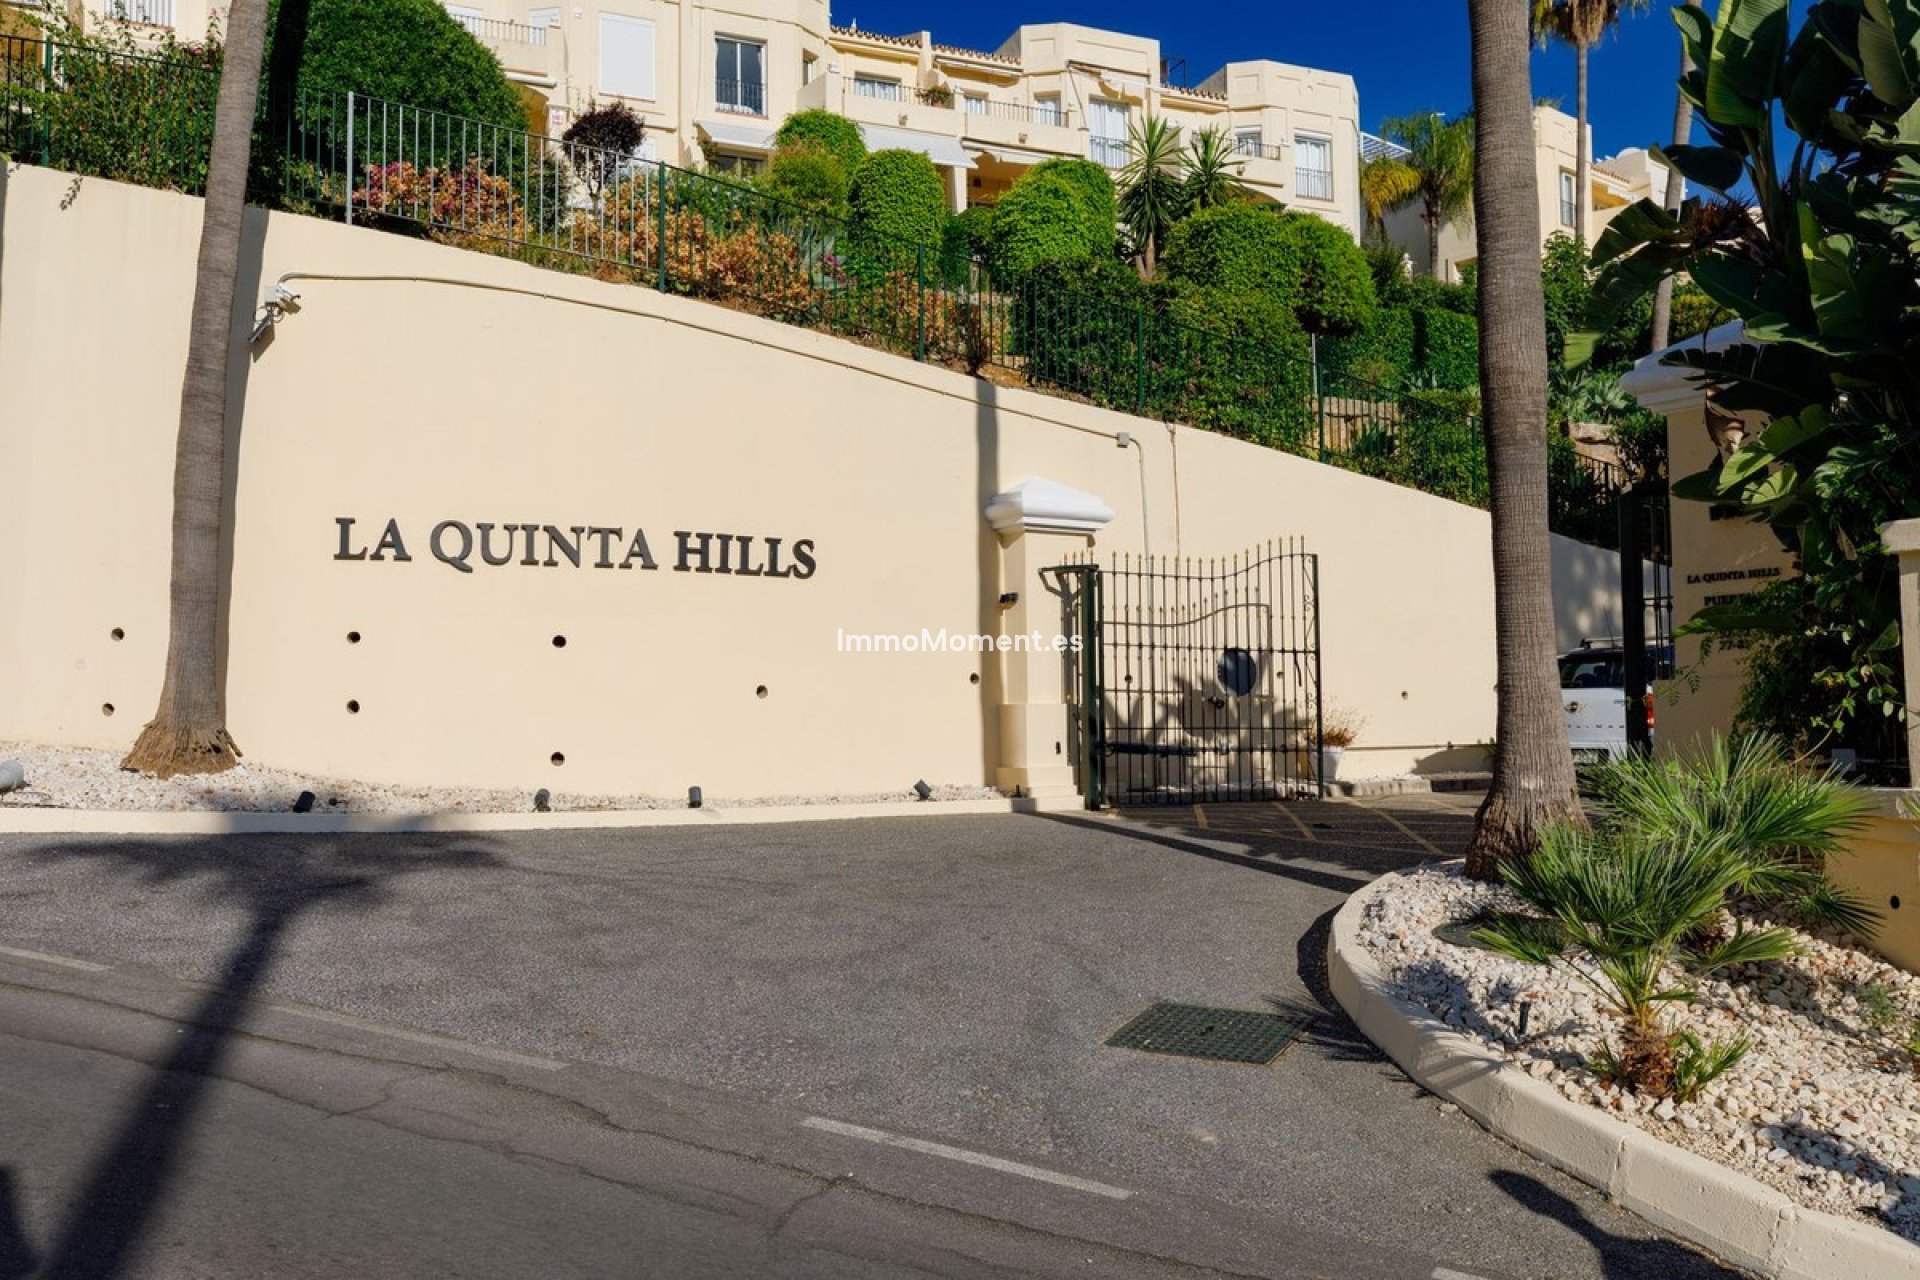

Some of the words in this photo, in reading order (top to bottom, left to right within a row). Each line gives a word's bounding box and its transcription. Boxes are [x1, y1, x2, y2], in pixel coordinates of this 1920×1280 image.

[333, 517, 413, 562] LA
[429, 520, 659, 574] QUINTA
[672, 530, 818, 580] HILLS
[1687, 575, 1701, 584] LA
[1703, 570, 1745, 584] QUINTA
[1748, 567, 1780, 578] HILLS
